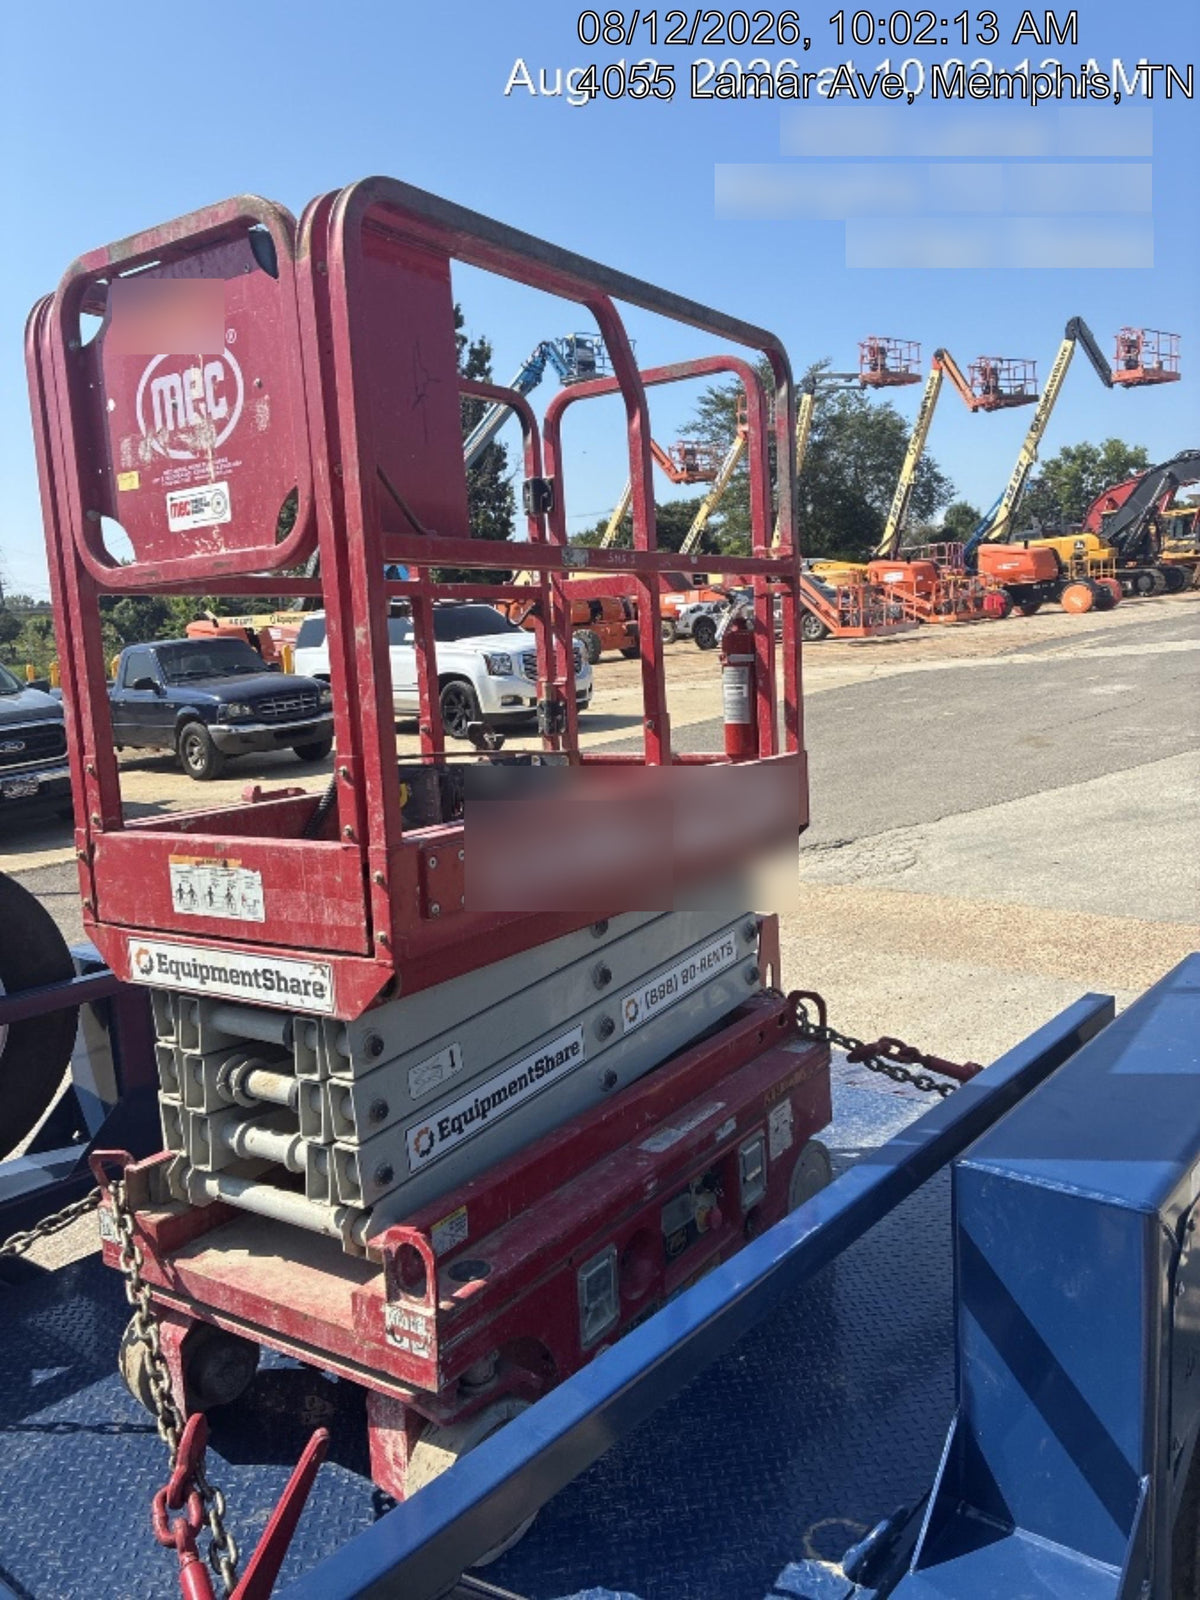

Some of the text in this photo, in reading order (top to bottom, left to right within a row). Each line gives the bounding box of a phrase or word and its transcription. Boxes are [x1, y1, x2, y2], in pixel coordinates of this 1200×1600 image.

[156, 952, 328, 999] EquipmentShare
[643, 940, 735, 1010] (888) 80-RENTS
[436, 1039, 581, 1141] EquipmentShare
